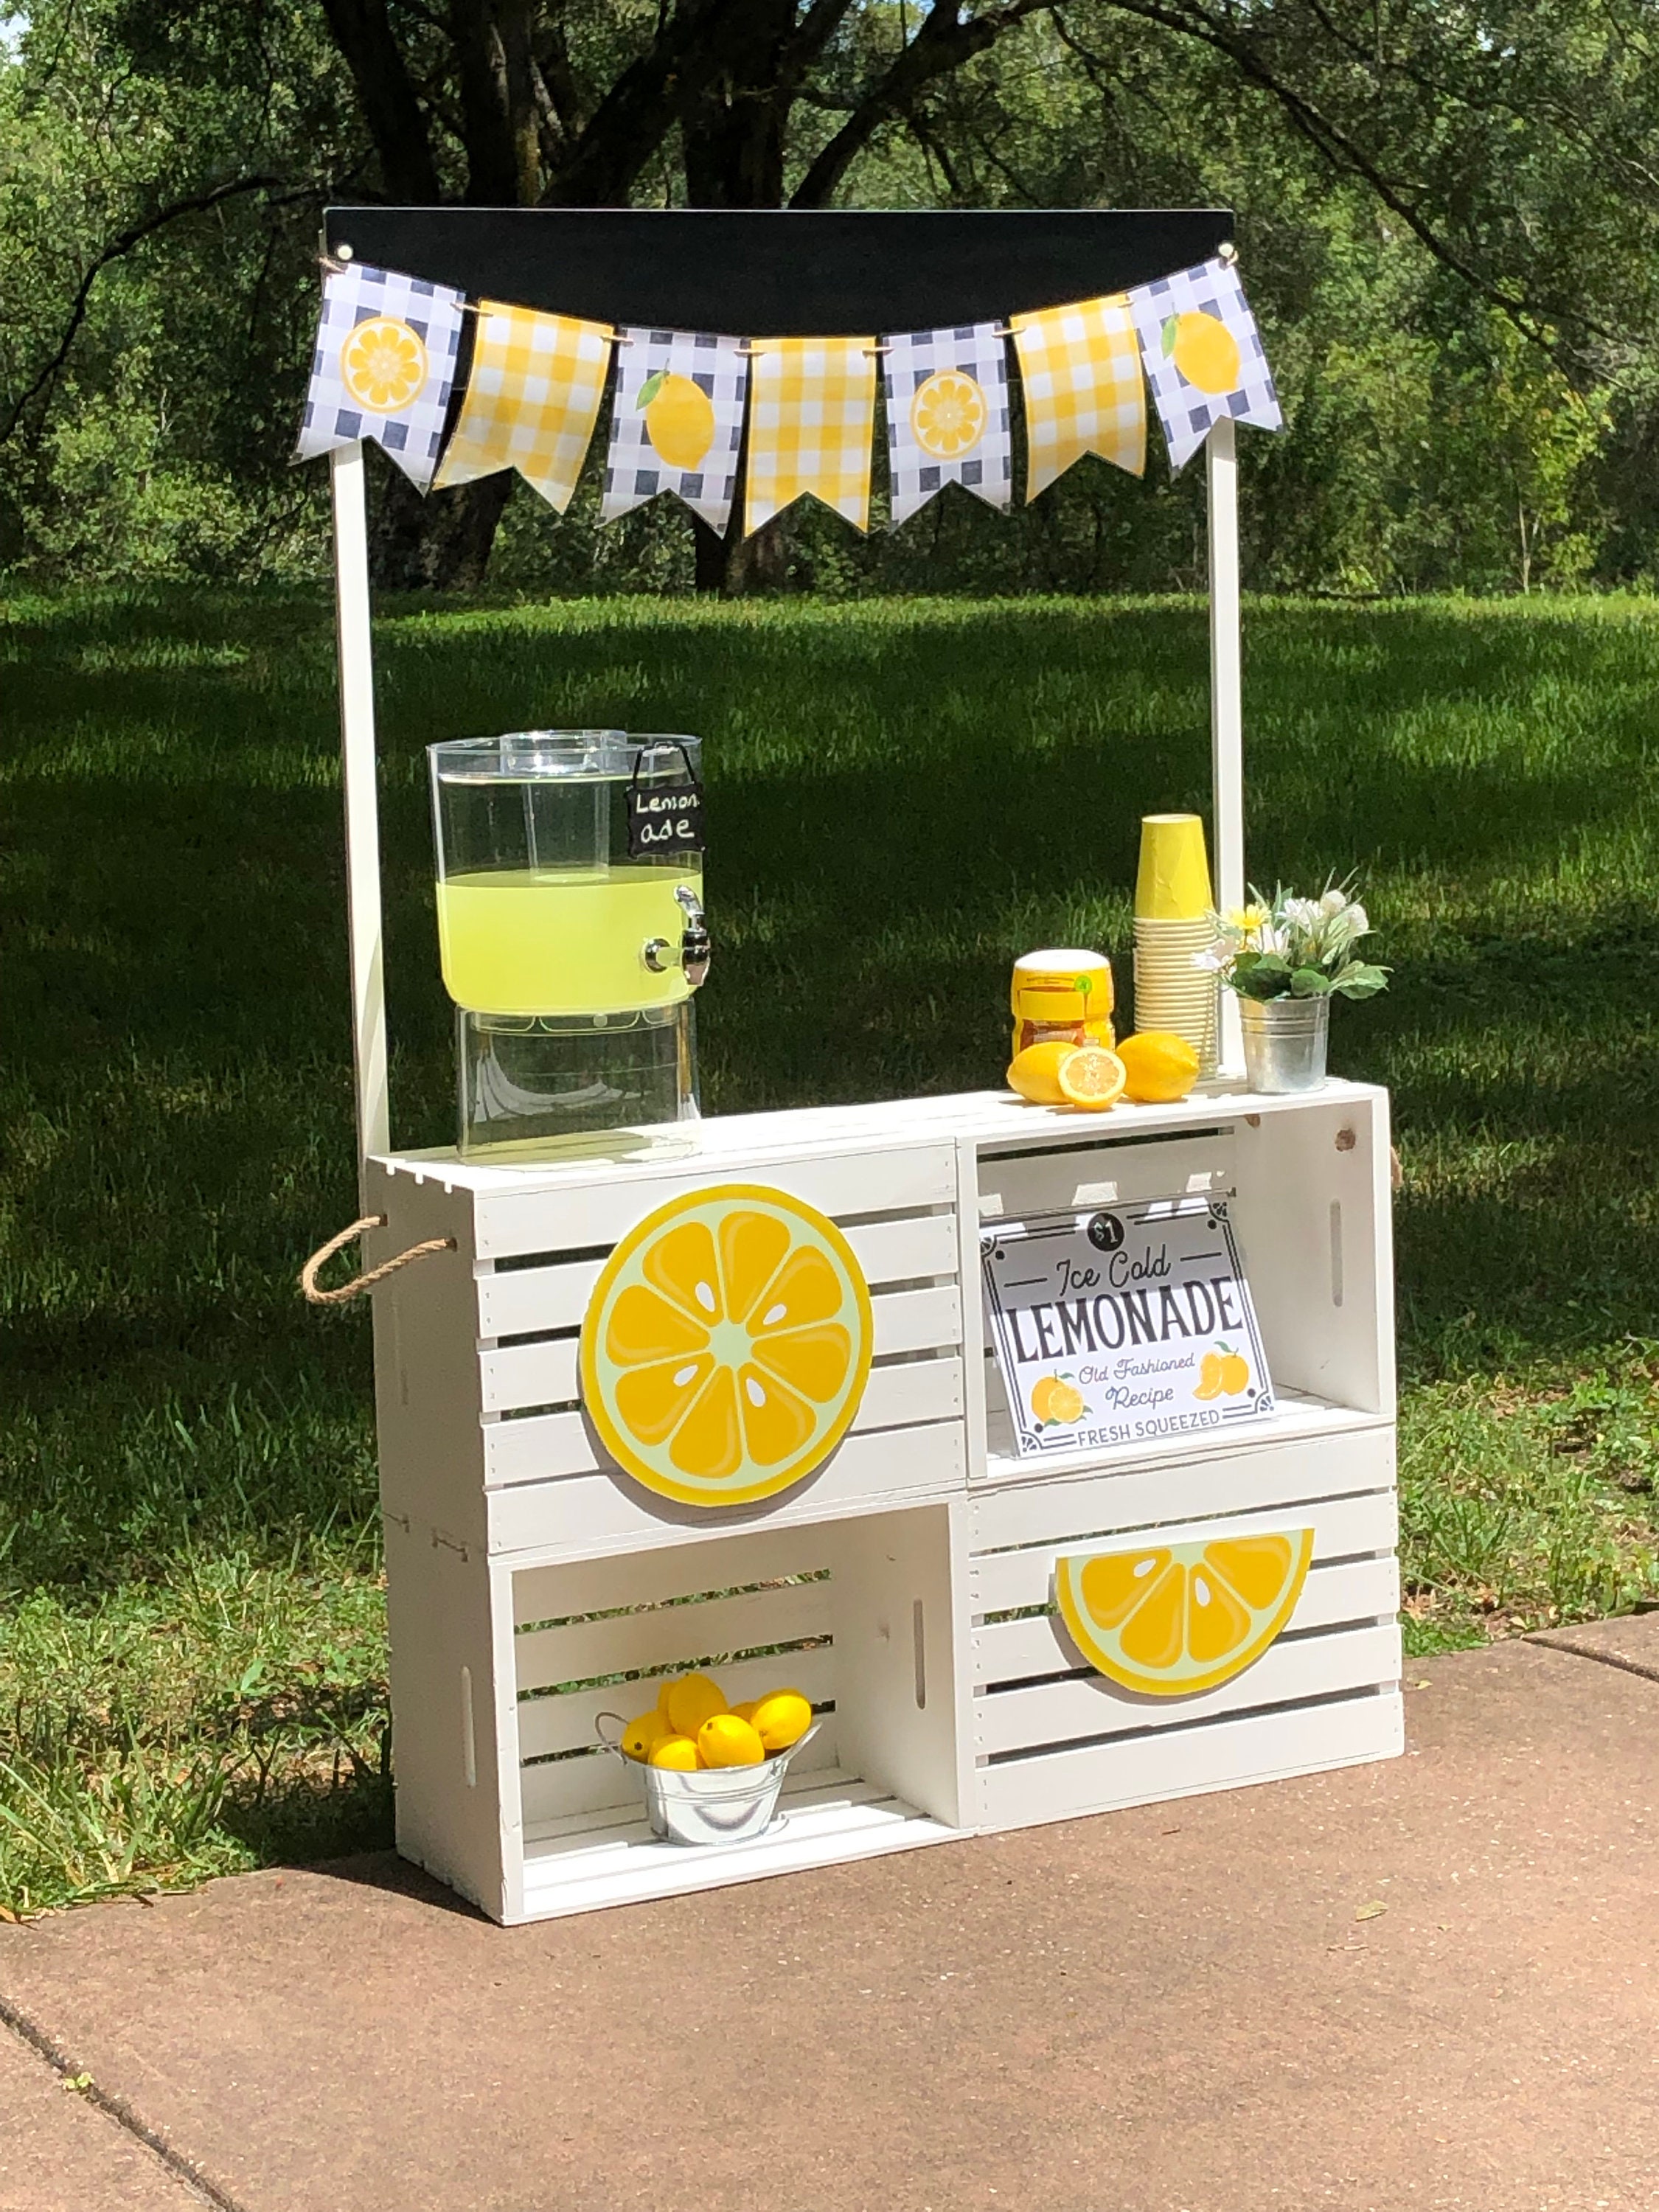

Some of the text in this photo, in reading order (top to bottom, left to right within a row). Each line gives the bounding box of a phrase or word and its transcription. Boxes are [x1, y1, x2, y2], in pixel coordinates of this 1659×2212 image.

[641, 819, 695, 843] ade
[1094, 1219, 1119, 1244] $1
[1056, 1243, 1171, 1296] Ice Cold
[1006, 1276, 1243, 1363] LEMONADE
[1079, 1352, 1195, 1385] Old Fashioned
[1105, 1385, 1174, 1410] Recipe
[1078, 1410, 1220, 1447] FRESH SQUEEZED
